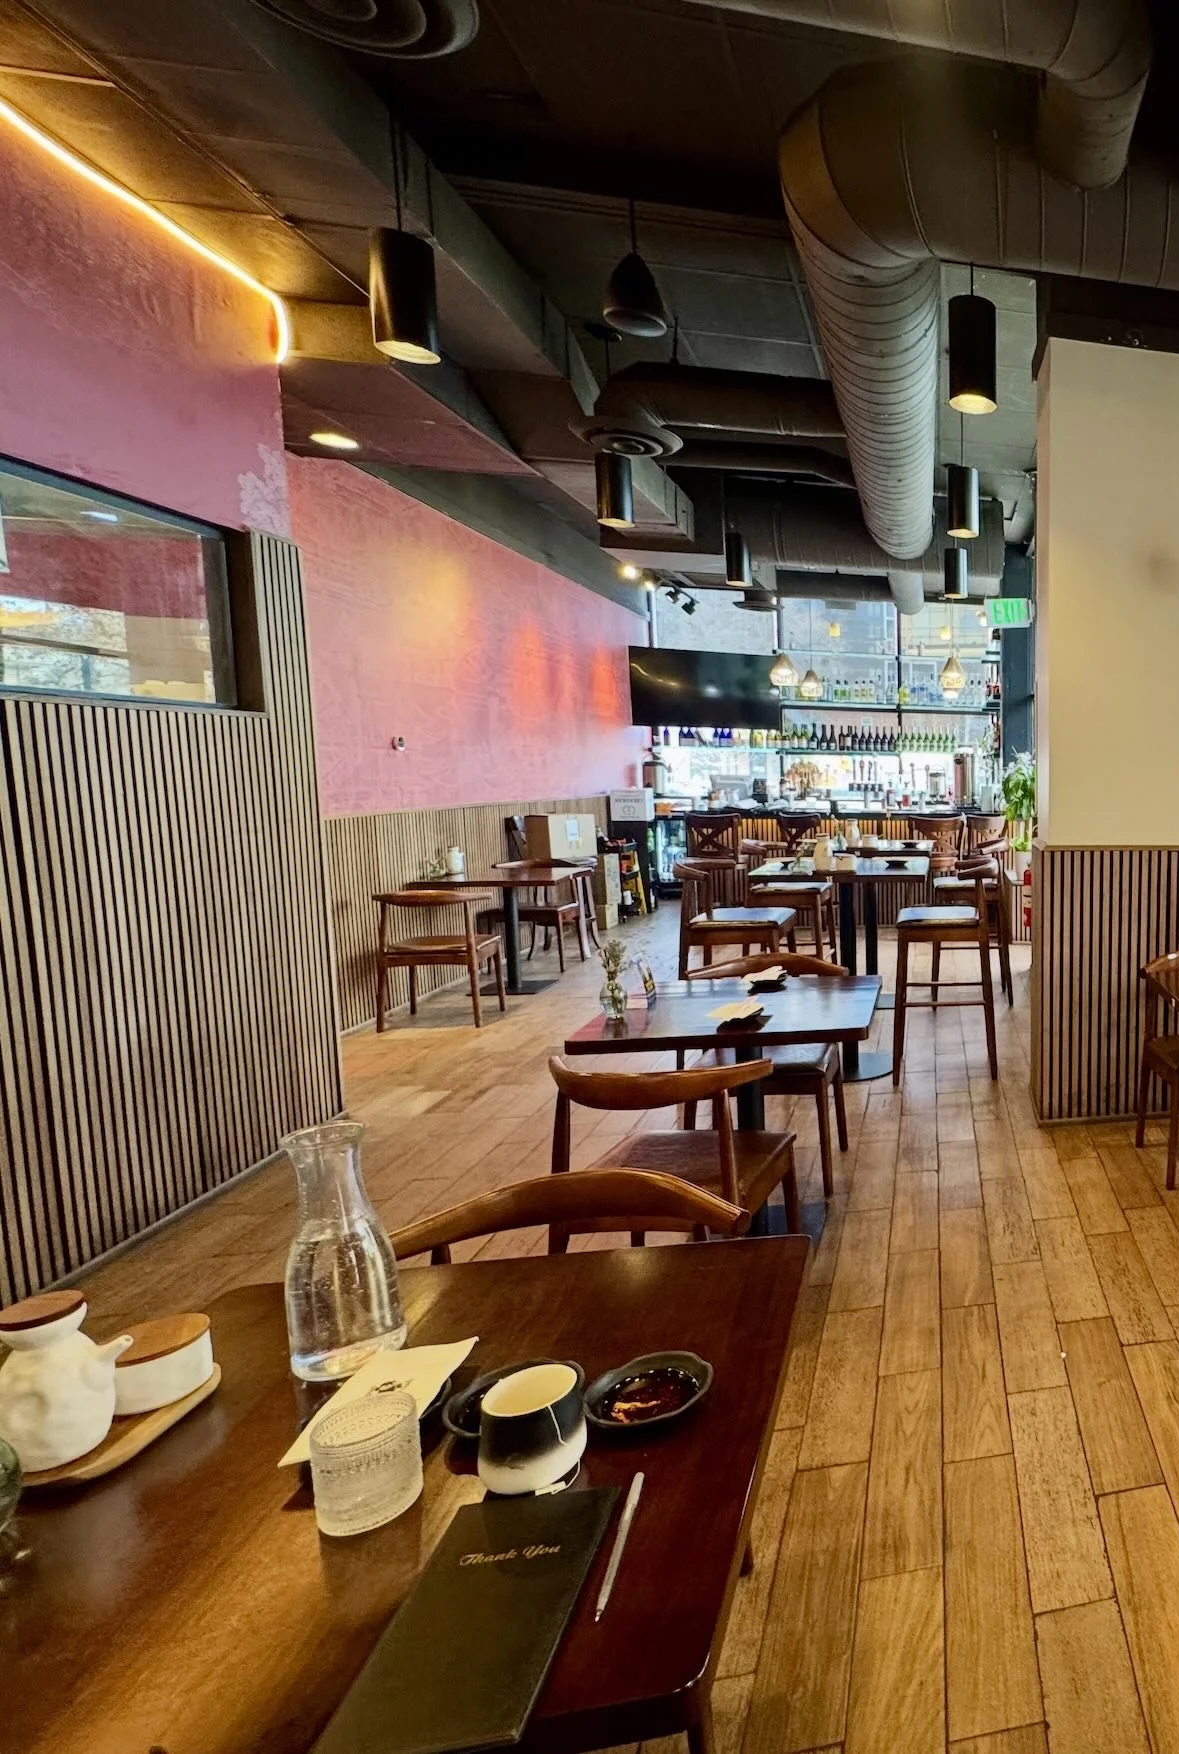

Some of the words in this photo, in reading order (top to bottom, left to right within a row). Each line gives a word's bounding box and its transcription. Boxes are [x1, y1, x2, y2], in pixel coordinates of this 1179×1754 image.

[992, 600, 1022, 625] EXIT
[459, 1548, 517, 1567] Thank
[523, 1544, 561, 1560] You
